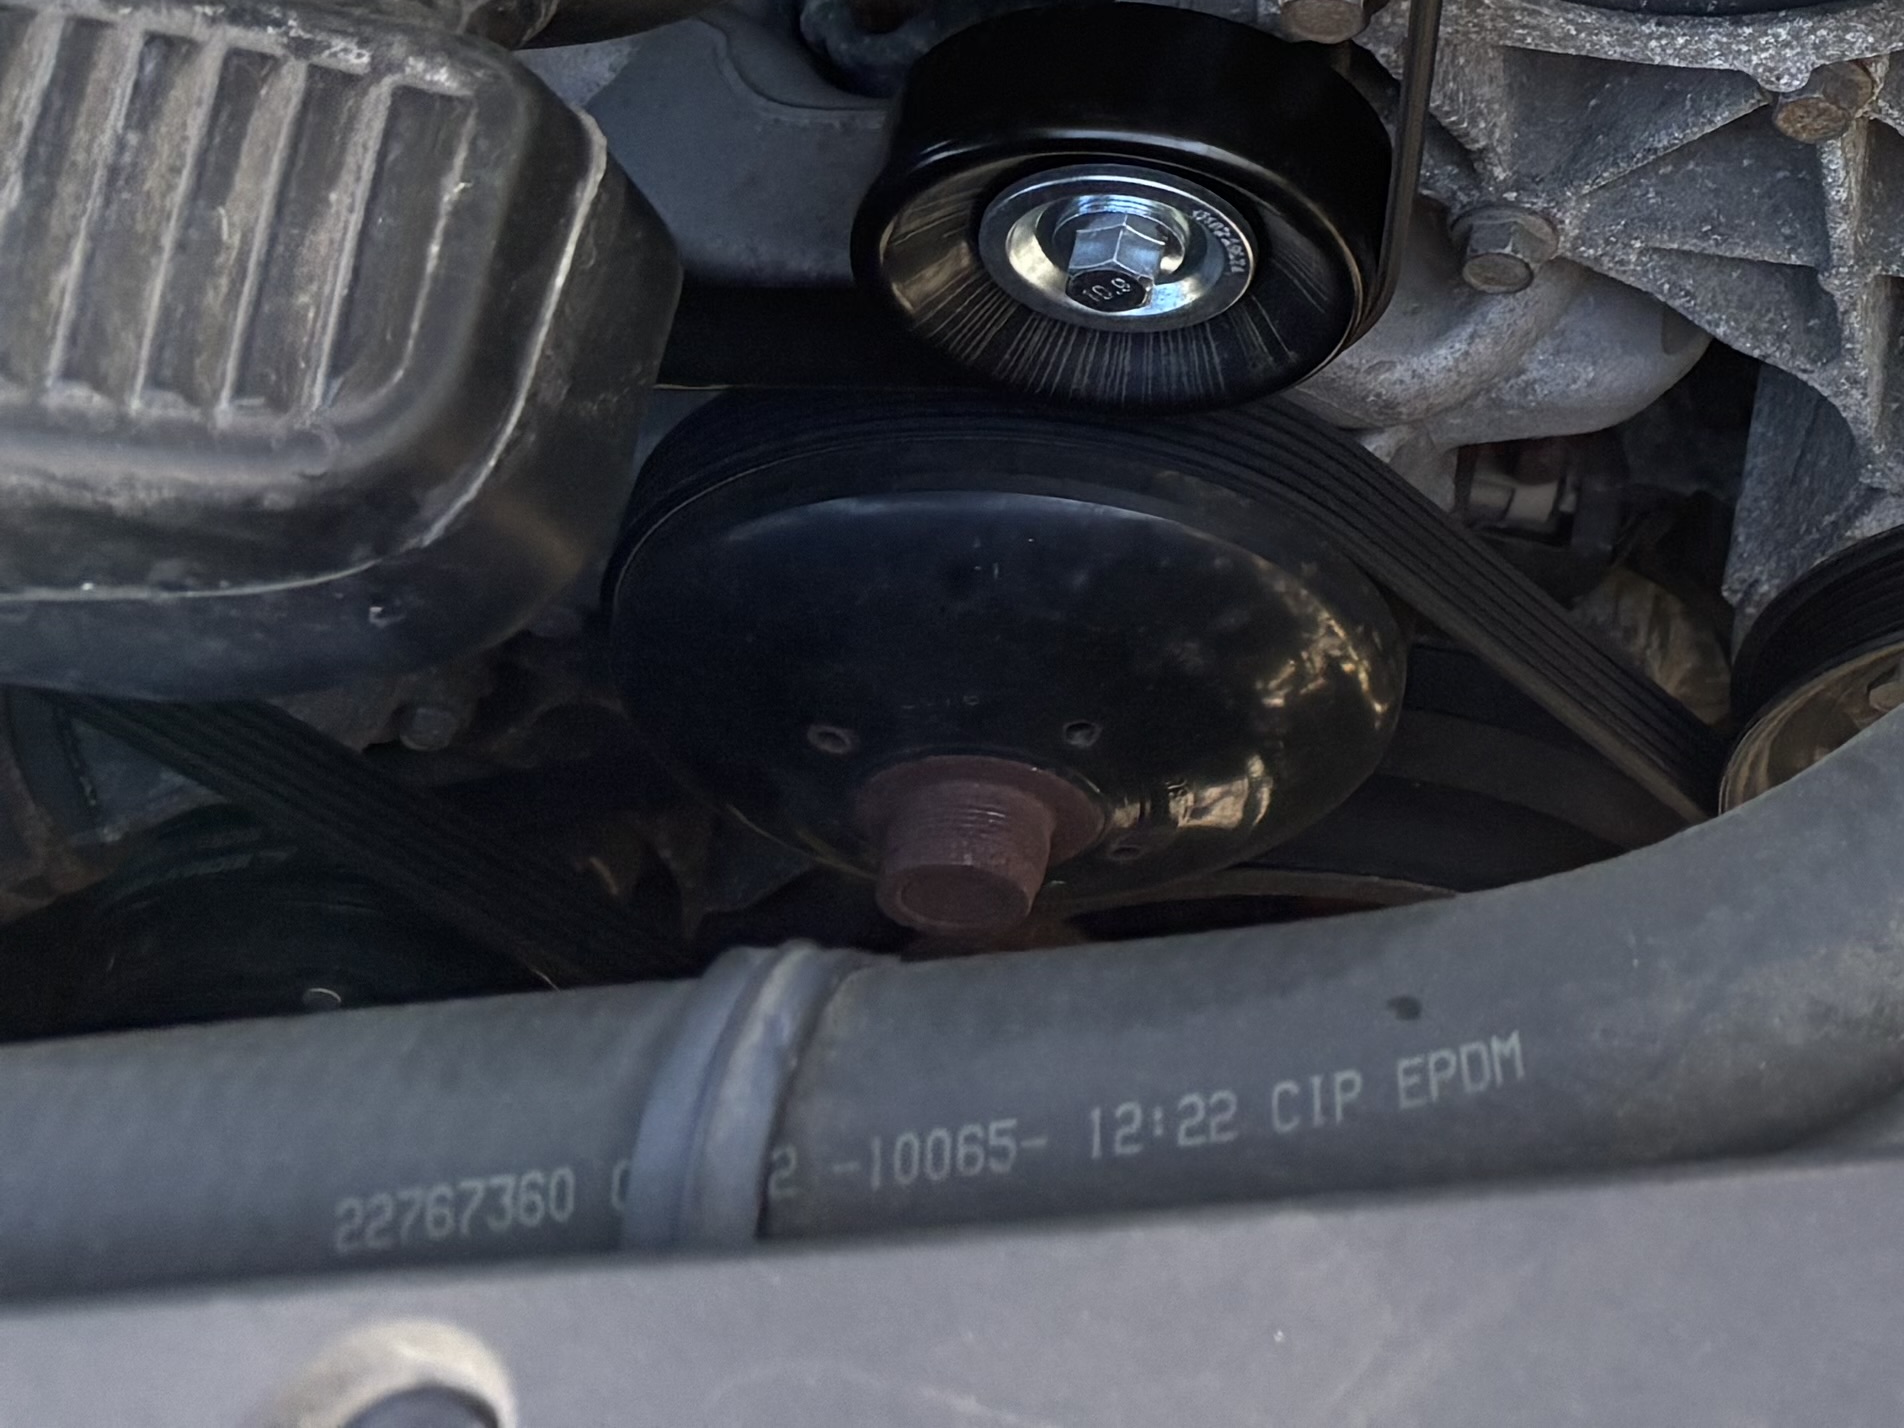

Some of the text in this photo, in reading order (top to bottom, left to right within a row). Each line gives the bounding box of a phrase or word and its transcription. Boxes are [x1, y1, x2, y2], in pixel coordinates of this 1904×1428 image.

[334, 1165, 577, 1255] 22767360
[1090, 1089, 1240, 1160] 12:22
[1271, 1068, 1364, 1134] CIP
[1396, 1029, 1527, 1112] EPDM
